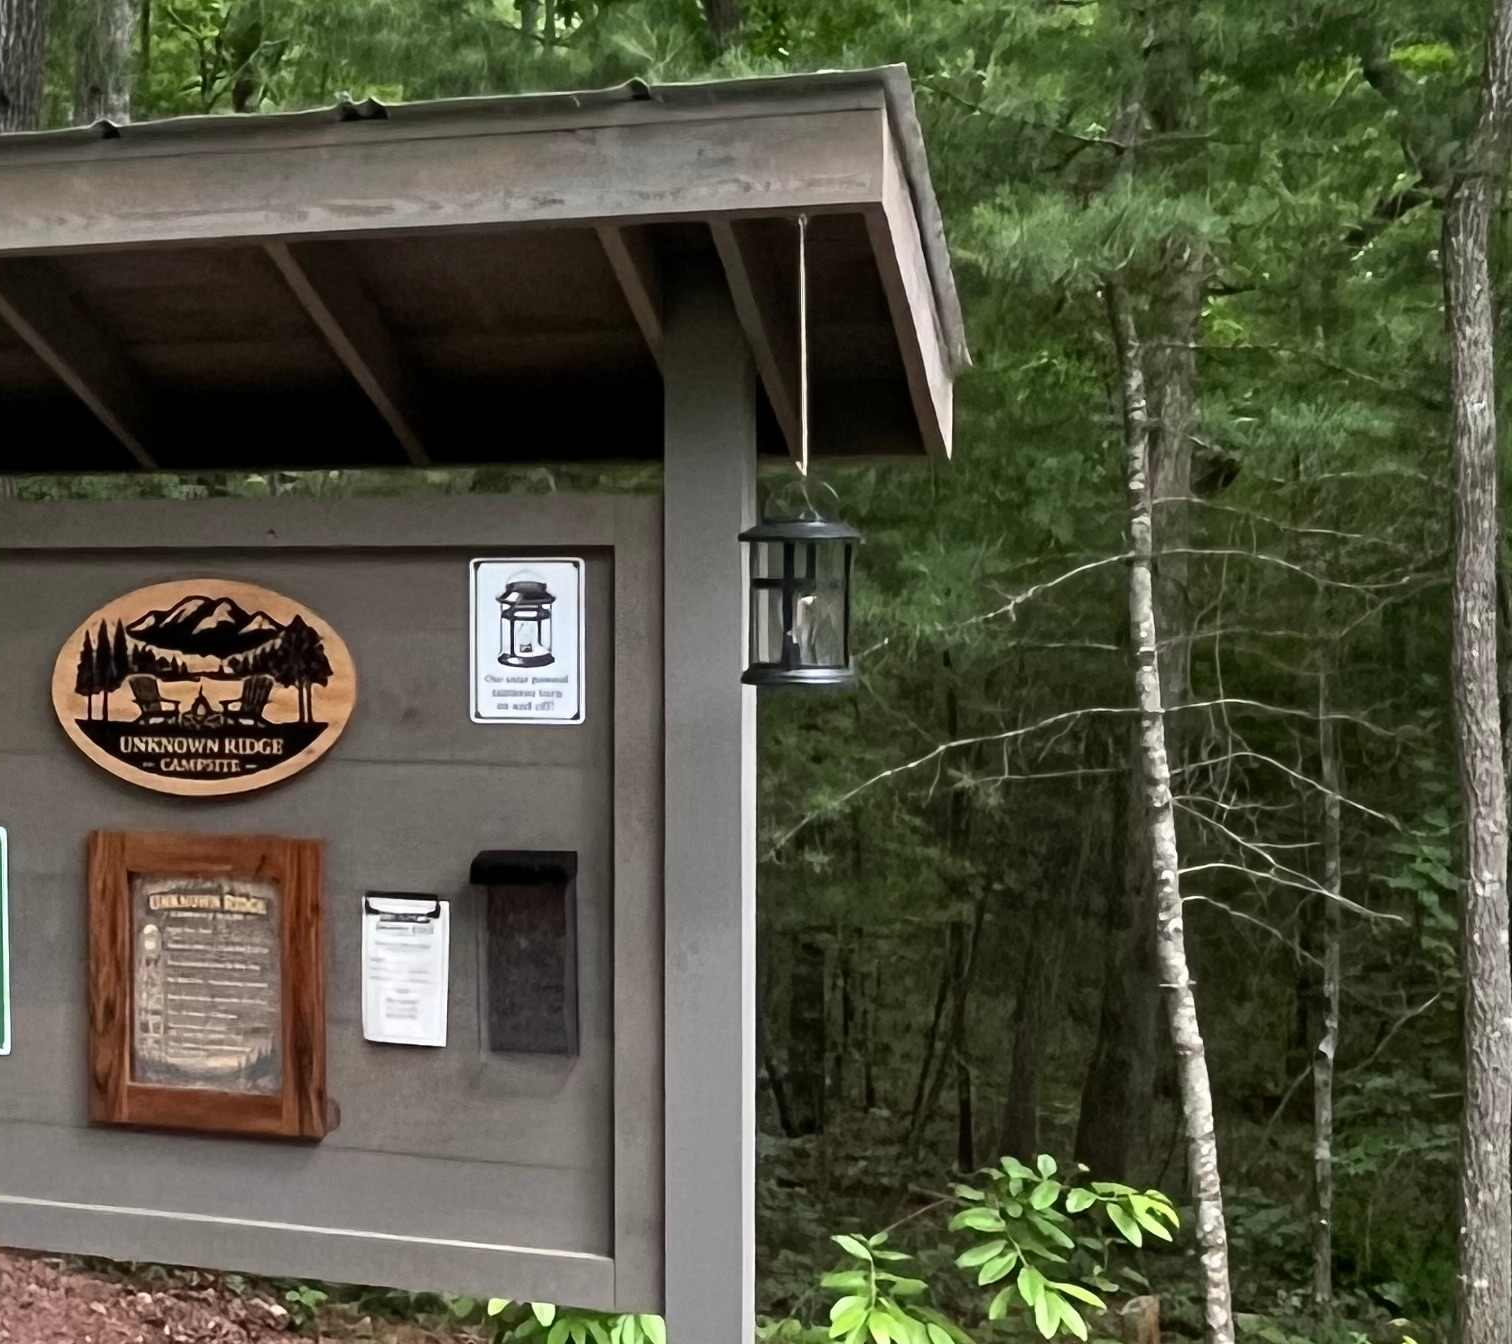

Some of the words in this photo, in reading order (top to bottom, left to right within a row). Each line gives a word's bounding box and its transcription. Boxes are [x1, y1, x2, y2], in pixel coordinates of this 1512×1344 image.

[120, 735, 219, 754] UNKNOWN
[224, 737, 284, 755] RIDGE
[160, 758, 240, 773] CAMPSITE
